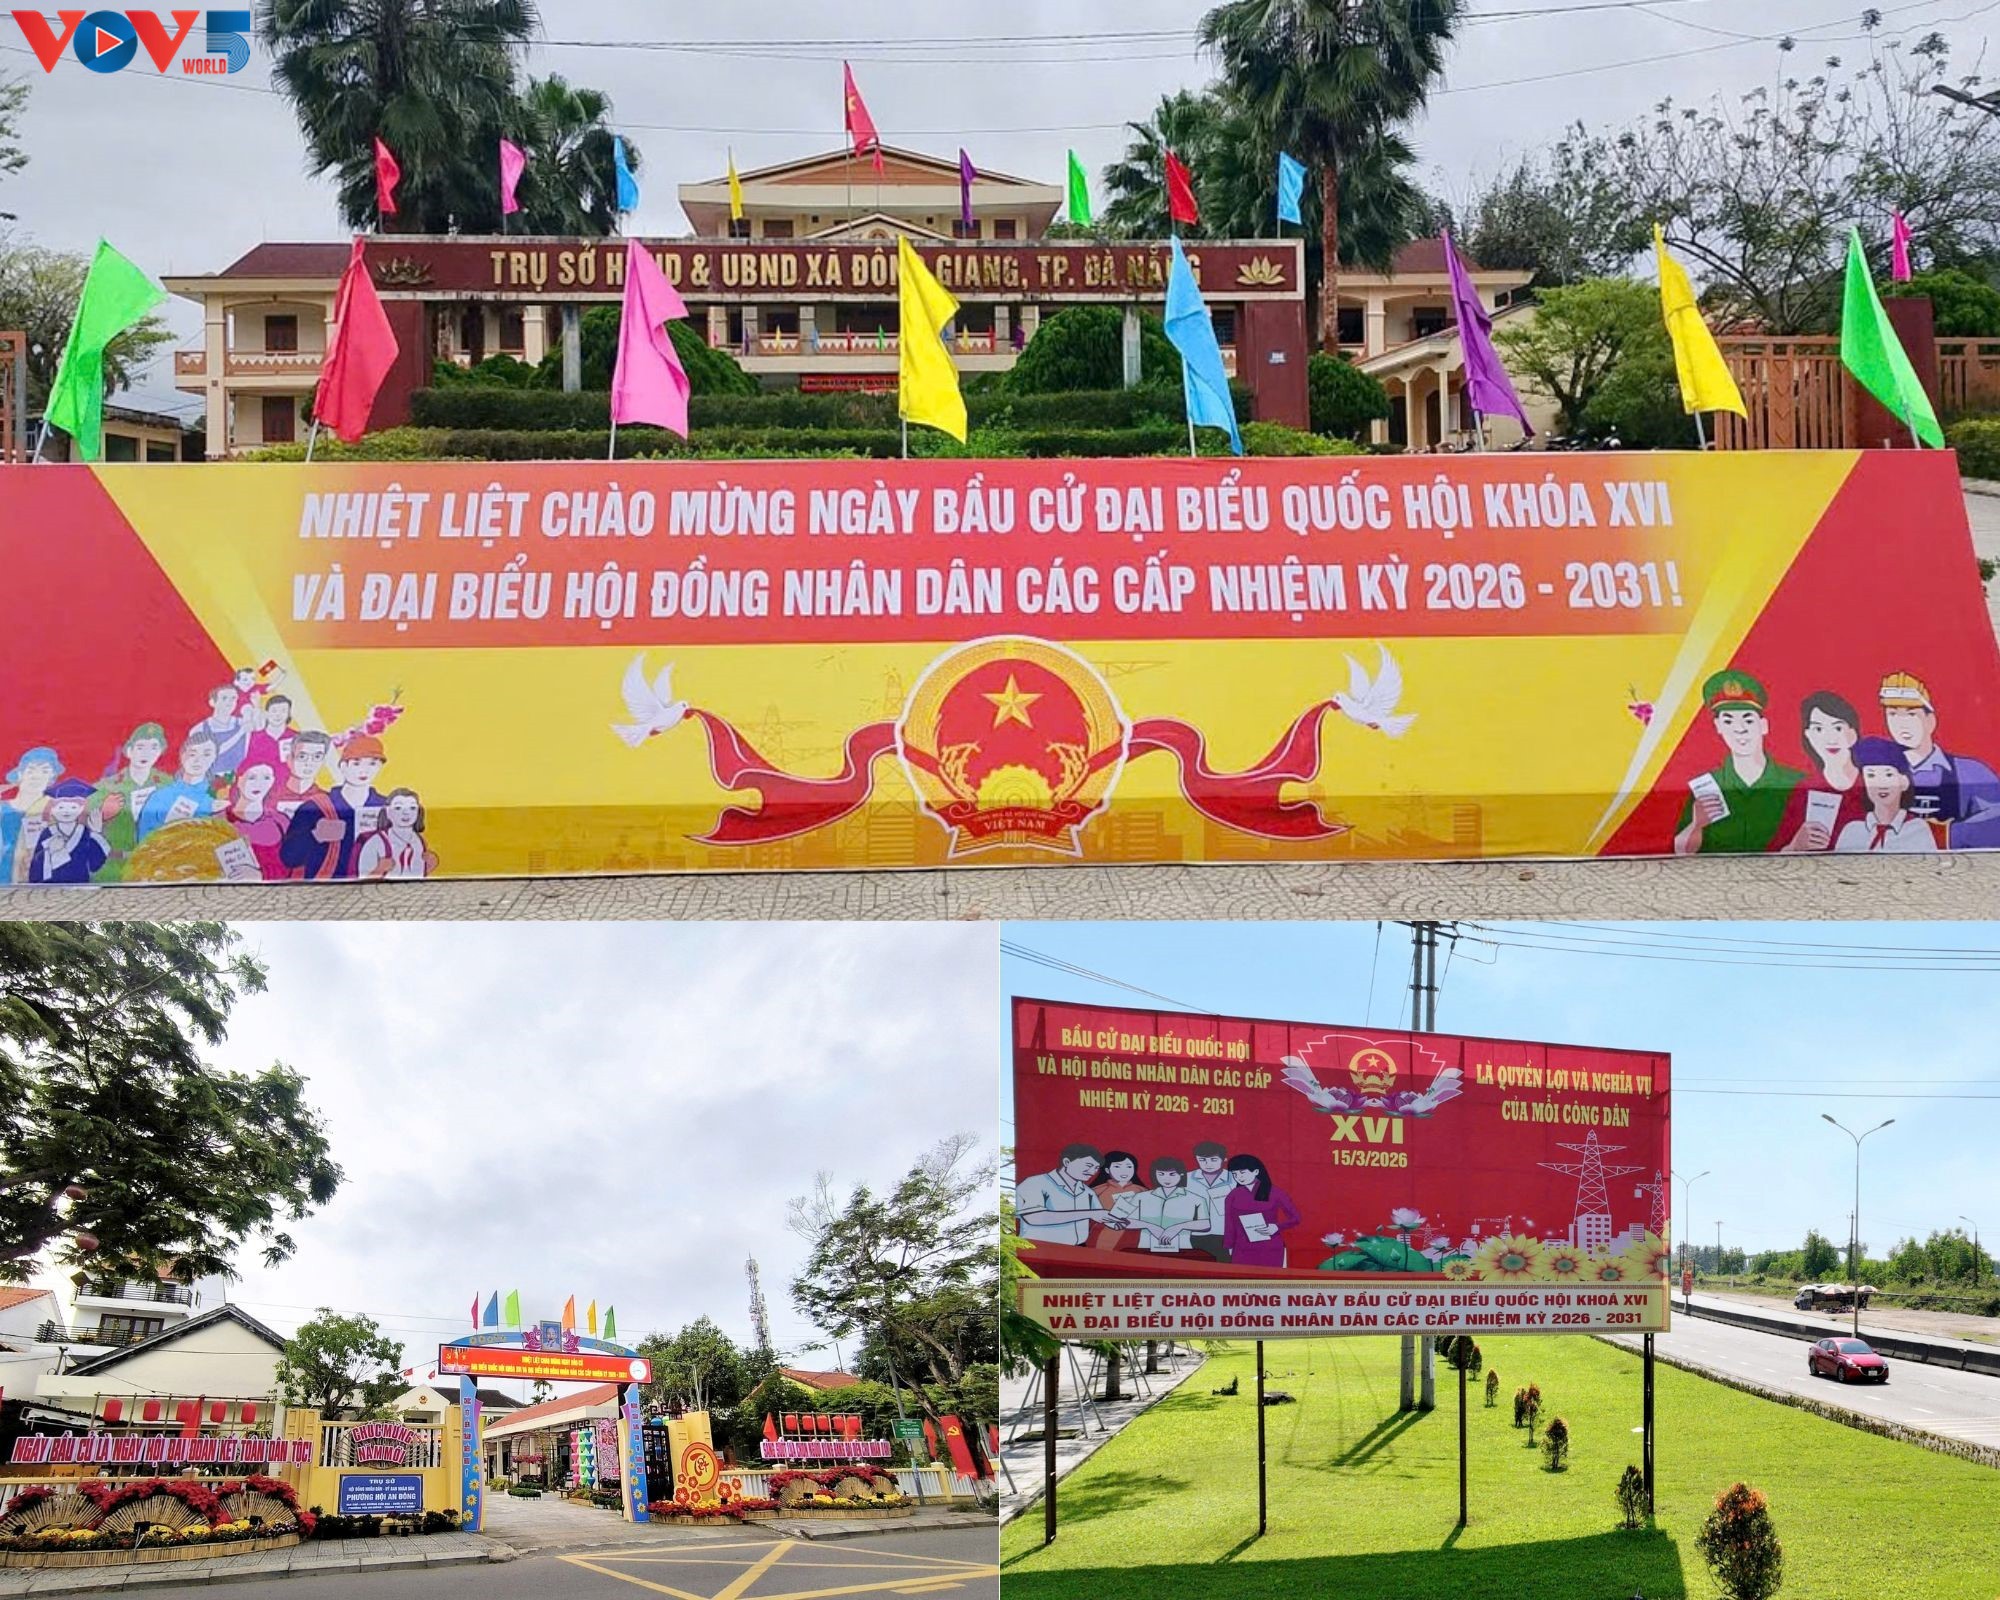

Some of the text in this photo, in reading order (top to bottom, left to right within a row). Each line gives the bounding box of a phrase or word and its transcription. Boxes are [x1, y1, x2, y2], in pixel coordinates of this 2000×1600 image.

[490, 251, 548, 292] TRỤ
[558, 240, 597, 286] SỞ
[690, 253, 710, 286] &
[722, 253, 800, 287] UBND
[806, 248, 843, 287] XÃ
[936, 254, 1028, 290] GIANG,
[1037, 255, 1074, 287] TP.
[1084, 248, 1117, 286] ĐÀ
[299, 467, 1673, 548] NHIỆT LIỆT CHÀO MỪNG NGÀY BẦU CỬ ĐẠI BIỂU QUỐC HỘI KHÓA XVI
[292, 562, 345, 620] VÀ
[359, 572, 437, 631] ĐẠI
[449, 553, 552, 620] BIỂU
[563, 561, 638, 629] HỘI
[650, 555, 769, 618] ĐỒNG
[783, 559, 902, 617] NHÂN
[916, 558, 1002, 615] DÂN
[1016, 557, 1099, 615] CÁC
[1112, 549, 1195, 614] CẤP
[1209, 555, 1347, 621] NHIỆM
[1357, 554, 1409, 610] KỲ
[1424, 563, 1526, 610] 2026
[1537, 582, 1553, 595] -
[1018, 819, 1046, 830] NAM
[1061, 1024, 1250, 1063] BẦU CỬ ĐẠI BIỂU QUỐC HỘI
[1037, 1053, 1272, 1089] VÀ HỘI ĐỒNG NHÂN DÂN CÁC CẤP
[1476, 1059, 1652, 1100] LÀ QUYỀN LỢI VÀ NGHĨA VỤ
[1079, 1088, 1128, 1112] NHIỆM
[1132, 1090, 1151, 1111] KỲ
[1155, 1095, 1190, 1113] 2026
[1202, 1098, 1235, 1115] 2031
[1501, 1094, 1630, 1127] CỦA MỖI CÔNG DÂN
[1330, 1114, 1404, 1145] XVI
[1332, 1149, 1408, 1168] 15/3/2026
[1043, 1292, 1106, 1310] NHIỆT
[1113, 1292, 1155, 1310] LIỆT
[1161, 1292, 1216, 1307] CHÀO
[1222, 1292, 1281, 1307] MỪNG
[1287, 1292, 1338, 1307] NGÀY
[1344, 1290, 1381, 1307] BẦU
[1386, 1290, 1412, 1307] CỬ
[1415, 1295, 1445, 1309] ĐẠI
[1450, 1289, 1490, 1306] BIỂU
[1495, 1290, 1539, 1307] QUỐC
[1544, 1291, 1571, 1309] HỘI
[1623, 1294, 1648, 1306] XVI
[1049, 1312, 1077, 1329] VÀ
[1084, 1316, 1119, 1331] ĐẠI
[1127, 1310, 1173, 1329] BIỂU
[1180, 1312, 1214, 1331] HỘI
[1220, 1310, 1274, 1328] ĐỒNG
[1281, 1312, 1334, 1328] NHÂN
[1340, 1312, 1378, 1327] DÂN
[1384, 1312, 1420, 1327] CÁC
[1425, 1309, 1460, 1326] CẤP
[1465, 1310, 1521, 1327] NHIỆM
[1526, 1310, 1547, 1325] KỲ
[1551, 1313, 1590, 1325] 2026
[1606, 1312, 1642, 1324] 2031
[12, 1433, 49, 1462] NGÀY
[50, 1431, 76, 1462] BẦU
[77, 1431, 96, 1462] CỬ
[96, 1433, 112, 1462] LÀ
[112, 1433, 144, 1462] NGÀY
[146, 1434, 165, 1467] HỘI
[167, 1437, 186, 1467] ĐẠI
[187, 1434, 217, 1462] ĐOÀN
[219, 1433, 238, 1461] KẾT
[240, 1435, 266, 1462] TOÀN
[268, 1437, 288, 1462] DÂN
